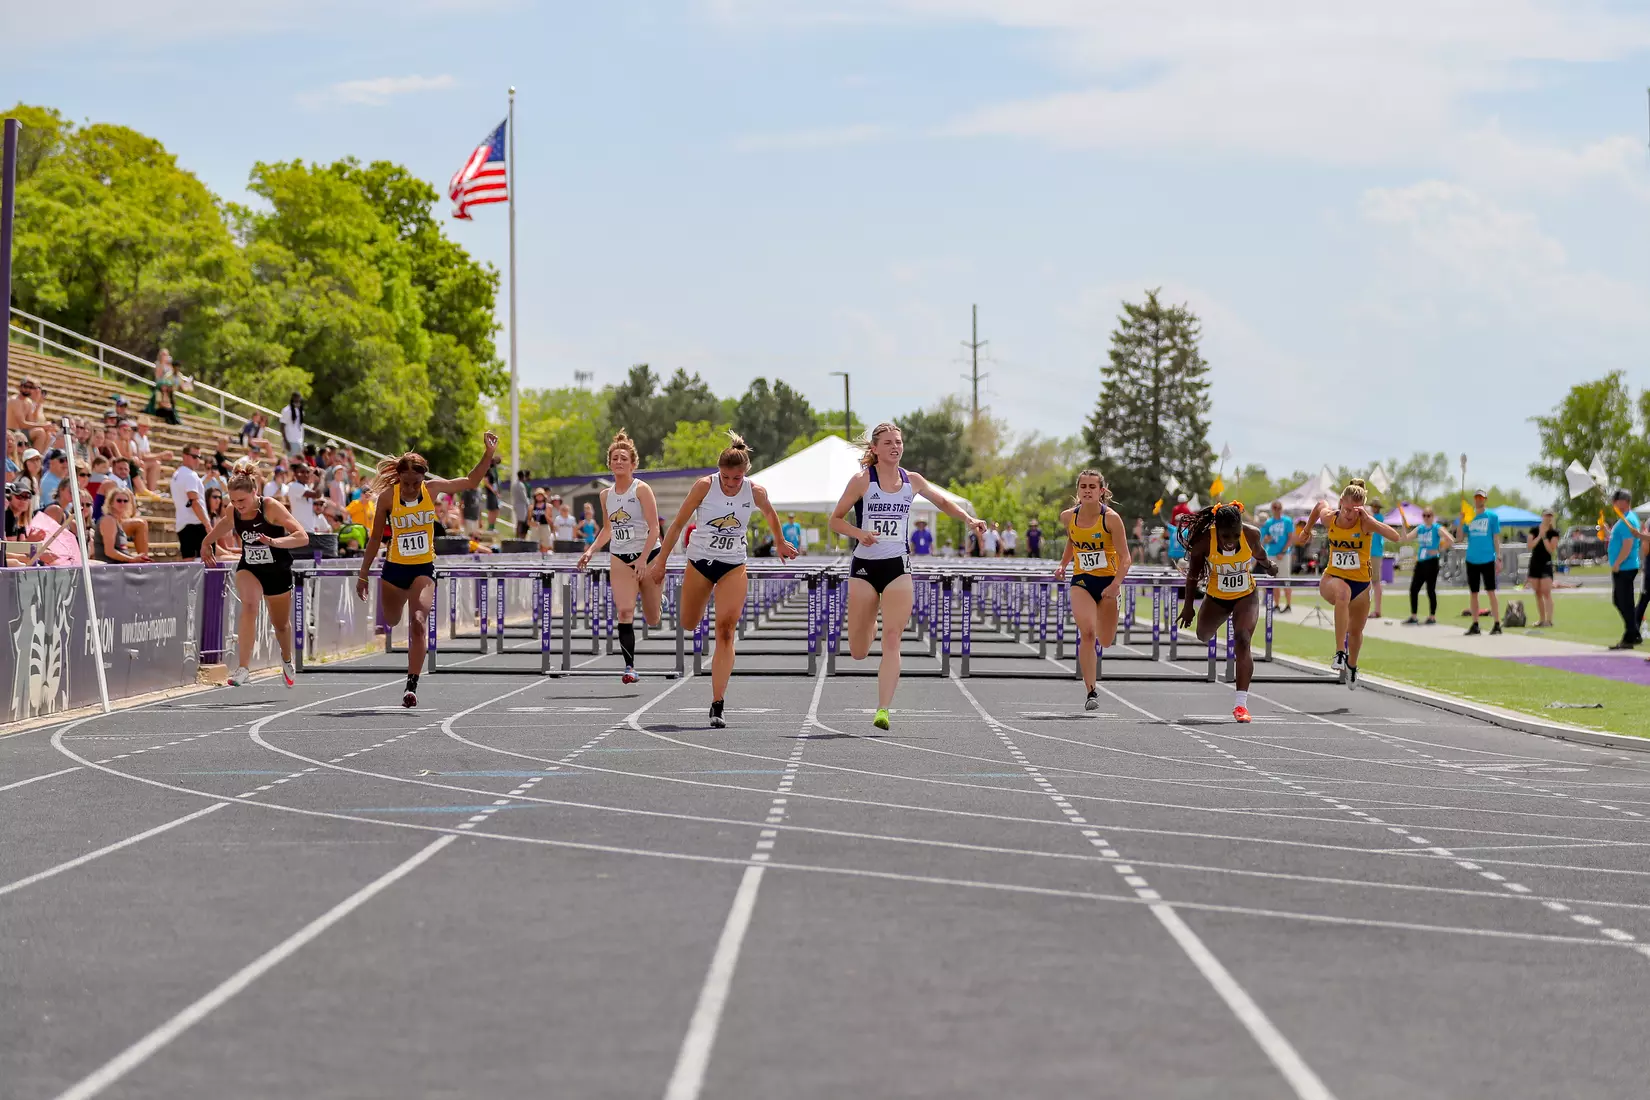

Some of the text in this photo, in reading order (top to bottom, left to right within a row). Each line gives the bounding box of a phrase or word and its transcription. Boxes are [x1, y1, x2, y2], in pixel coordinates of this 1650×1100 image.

[867, 503, 911, 515] WEBER STATE
[393, 510, 435, 529] UNC
[873, 520, 898, 536] 542
[402, 535, 424, 551] 410
[709, 535, 735, 551] 296
[1329, 539, 1363, 549] NAU
[248, 549, 269, 561] 252
[1081, 552, 1101, 567] 357
[1335, 553, 1356, 566] 373
[1222, 574, 1244, 588] 409
